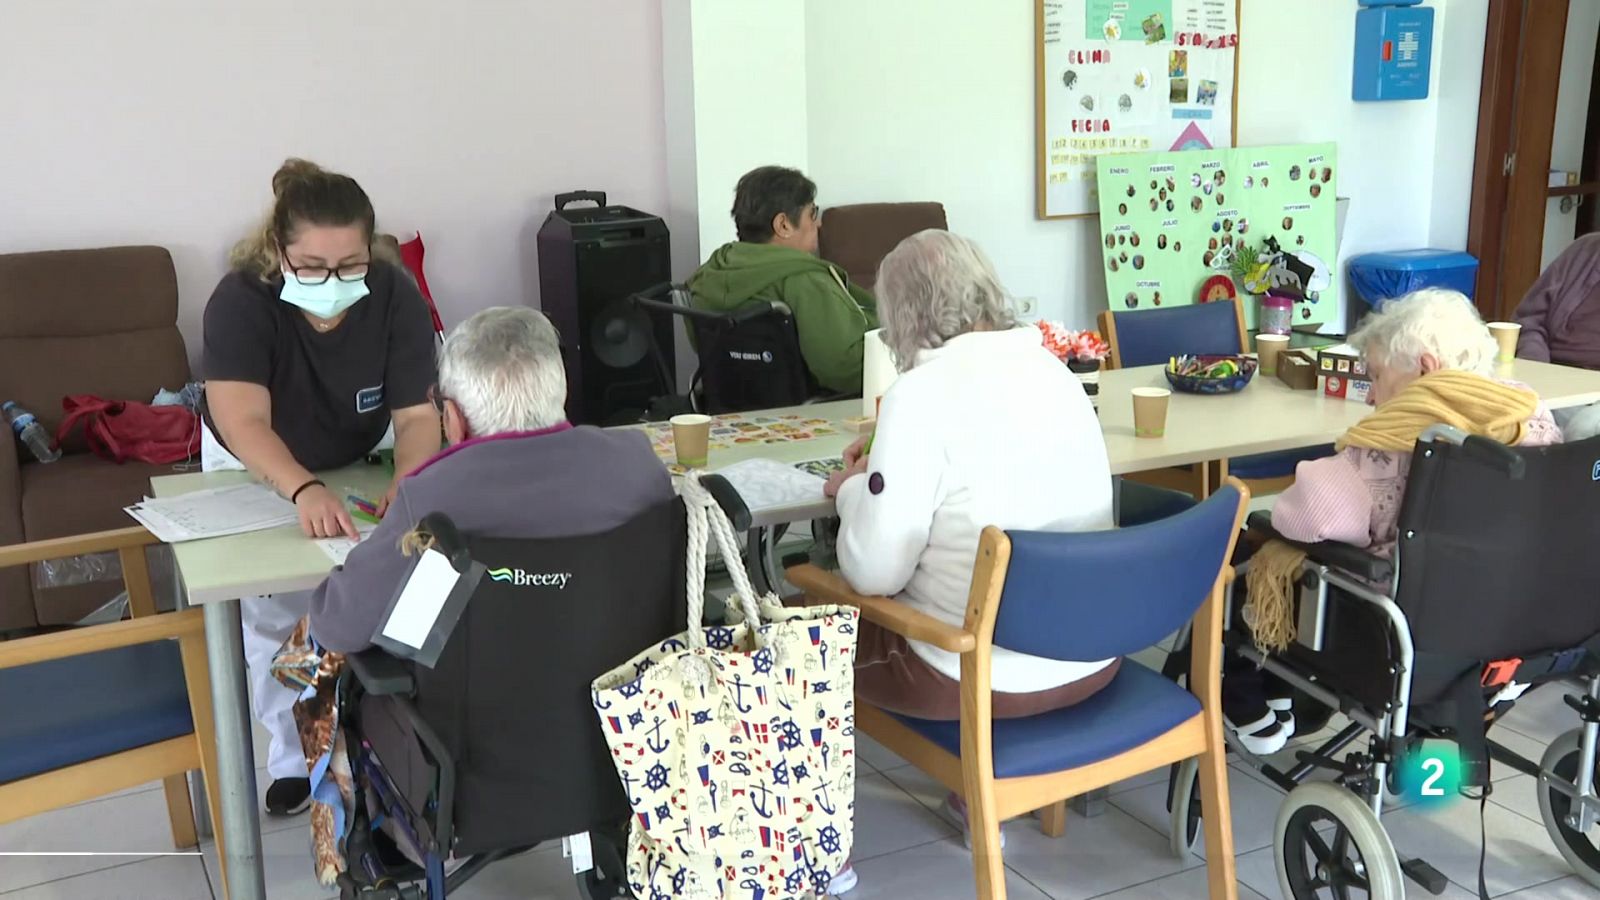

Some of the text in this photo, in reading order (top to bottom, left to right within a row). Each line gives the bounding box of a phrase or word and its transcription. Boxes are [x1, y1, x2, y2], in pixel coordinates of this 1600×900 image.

[1068, 49, 1111, 64] CLIMA
[1071, 119, 1110, 133] FECHA
[1201, 161, 1221, 169] MARZO
[1308, 155, 1324, 163] MAYO
[514, 568, 571, 589] Breezy
